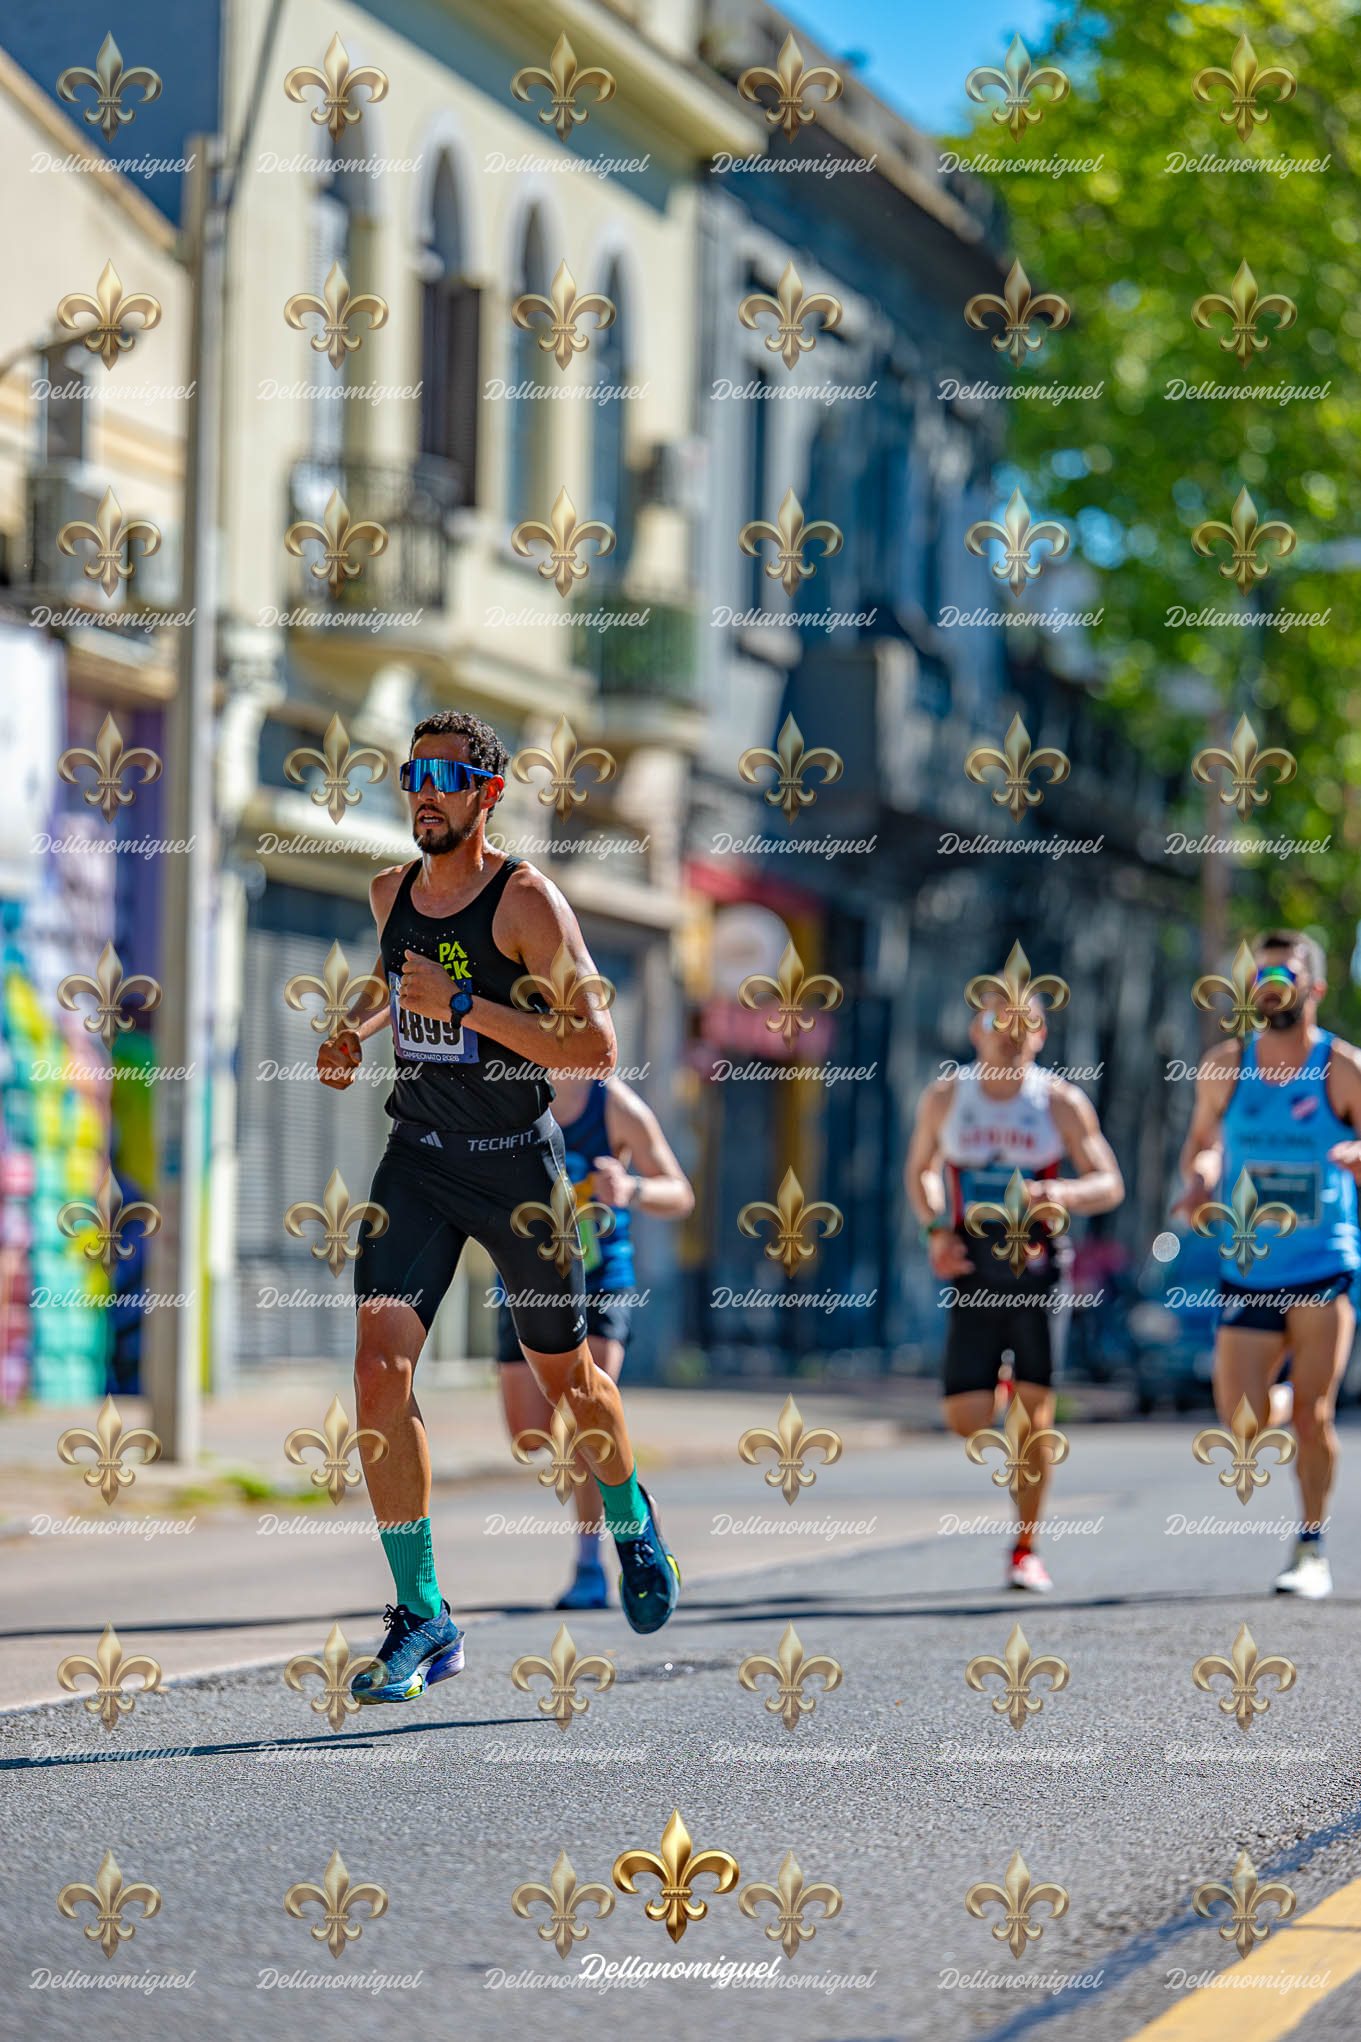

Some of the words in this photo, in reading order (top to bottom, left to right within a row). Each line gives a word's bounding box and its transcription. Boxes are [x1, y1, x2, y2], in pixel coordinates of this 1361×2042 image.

[439, 941, 467, 962] PA
[399, 1008, 460, 1046] 4899
[467, 1129, 534, 1152] TECHFIT
